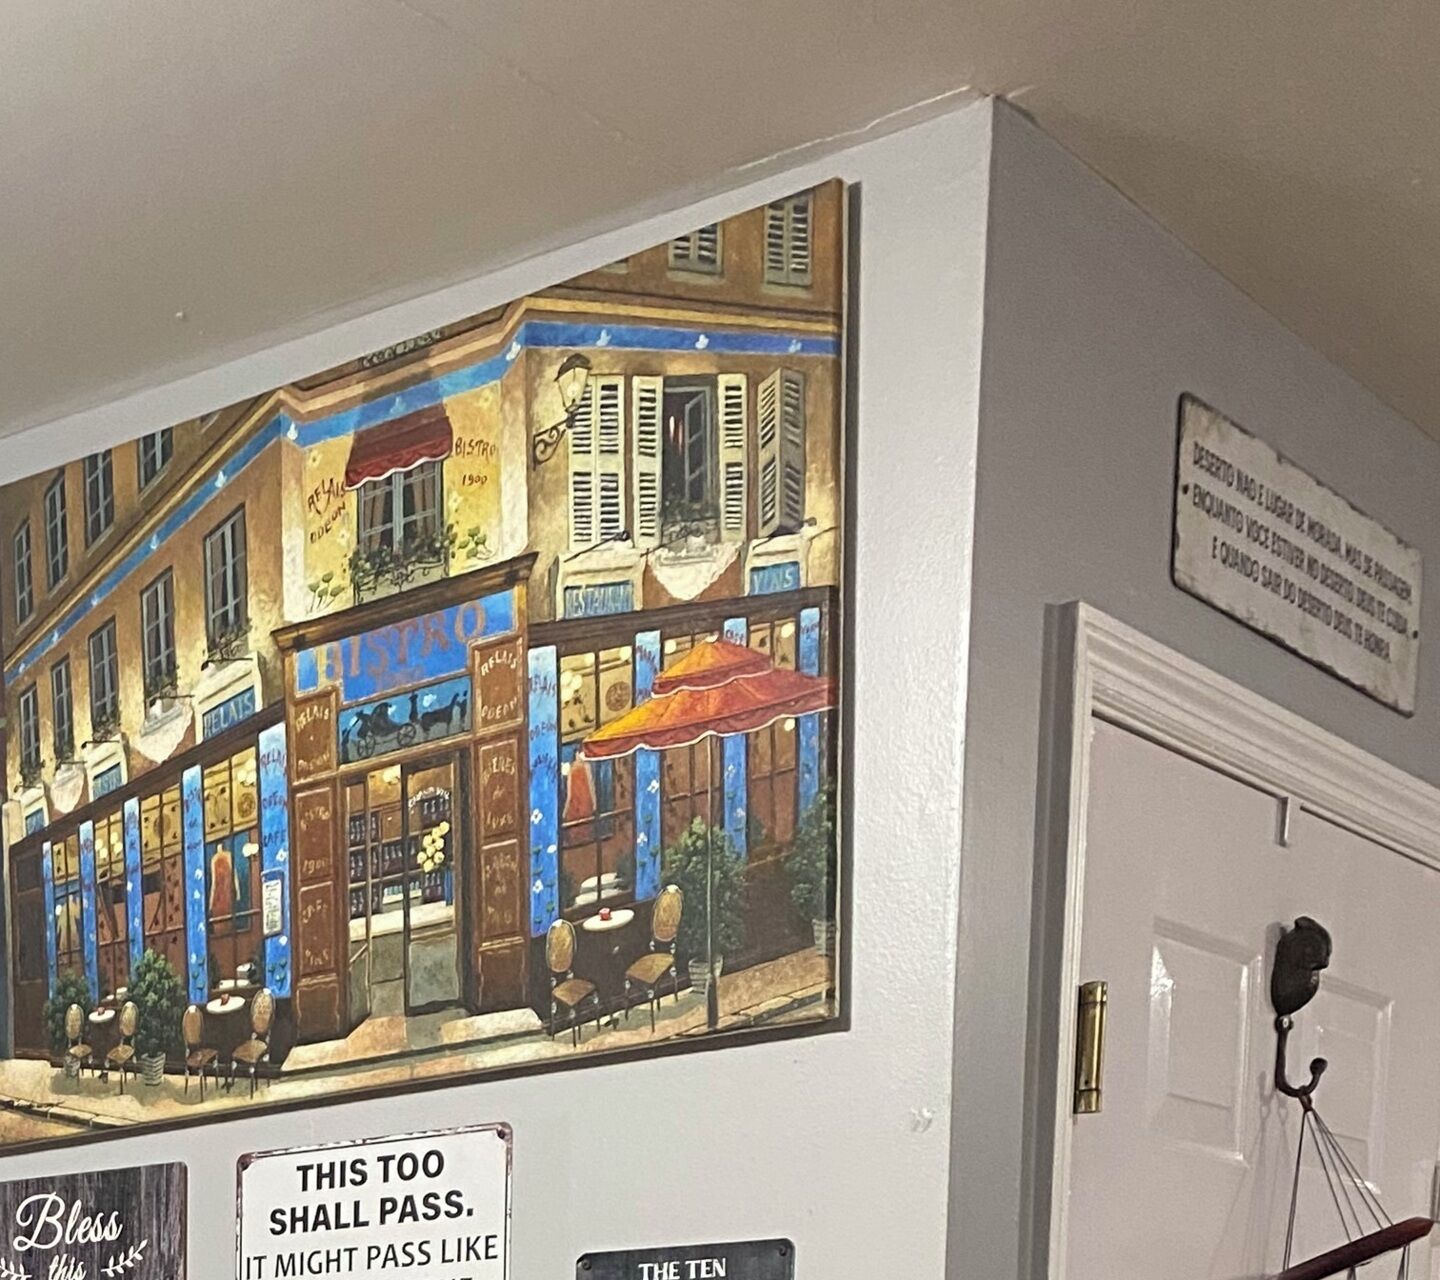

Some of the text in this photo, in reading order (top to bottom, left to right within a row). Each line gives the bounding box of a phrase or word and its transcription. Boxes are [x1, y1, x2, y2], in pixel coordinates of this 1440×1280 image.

[454, 436, 497, 463] BISTRO
[317, 600, 486, 682] BISTRO
[296, 1149, 445, 1193] THIS TOO
[13, 1191, 123, 1252] Bless
[269, 1190, 475, 1236] SHALL PASS.
[245, 1234, 499, 1280] IT MIGHT PASS LIKE
[685, 1257, 726, 1280] TEN
